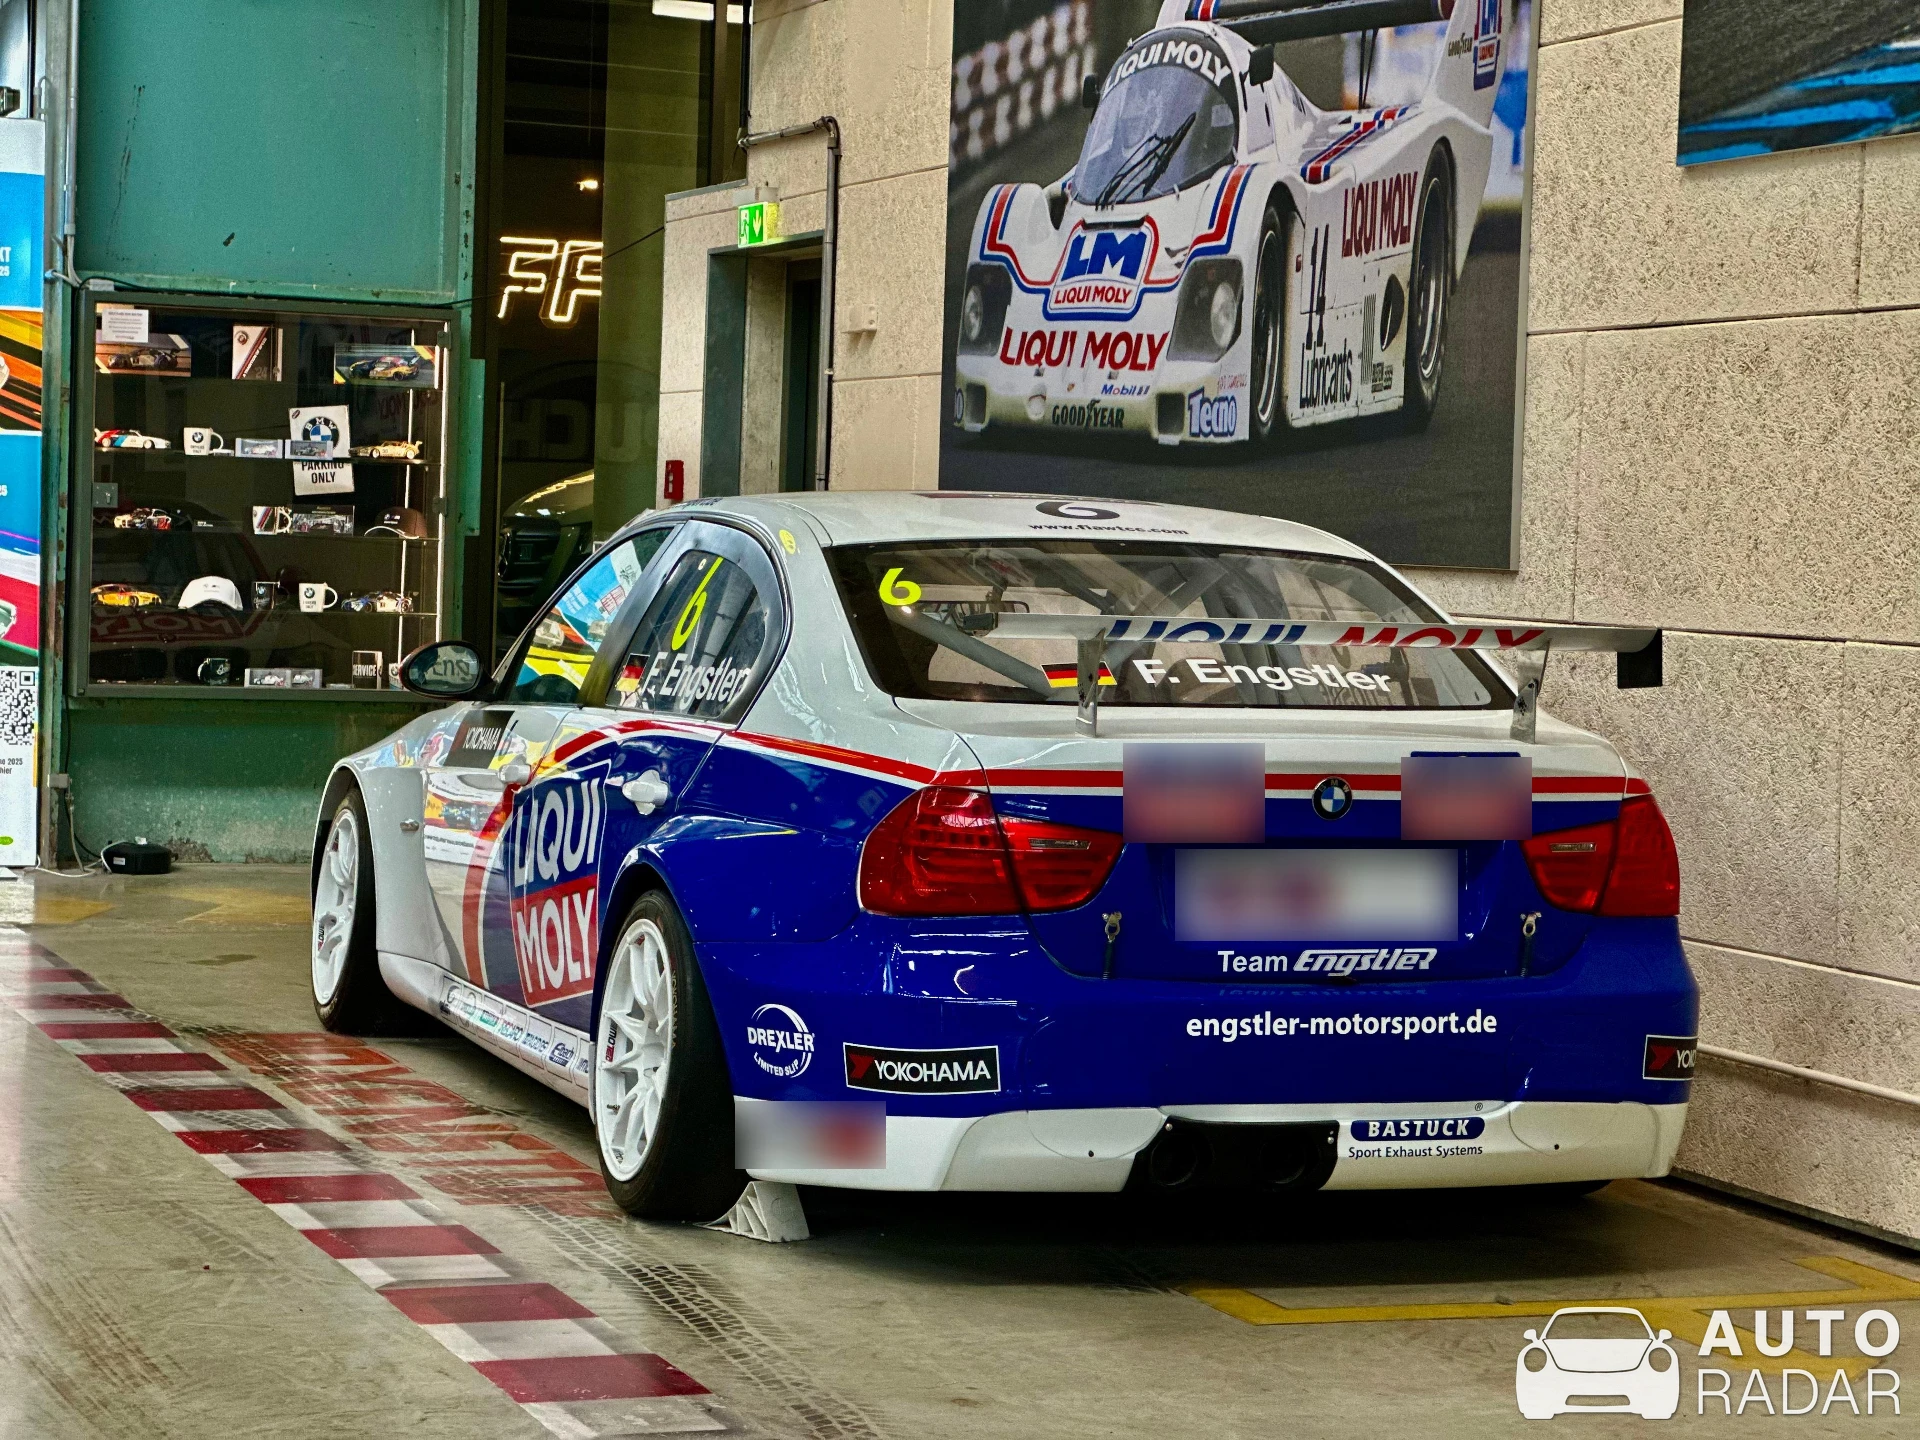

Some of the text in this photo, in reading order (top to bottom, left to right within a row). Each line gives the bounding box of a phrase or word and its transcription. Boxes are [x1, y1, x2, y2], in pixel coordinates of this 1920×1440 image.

[1101, 40, 1232, 100] LIQUI MOLY
[1341, 171, 1418, 259] LIQUI MOLY
[1061, 231, 1147, 281] LM
[1054, 285, 1132, 304] LIQUI MOLY
[1305, 223, 1329, 351] 14
[1000, 326, 1170, 371] LIQUI MOLY
[1101, 383, 1137, 396] Mobil
[1300, 337, 1353, 410] Lubricants
[305, 417, 338, 431] BMW
[1052, 398, 1125, 428] GOODYEAR
[1188, 385, 1238, 438] Tecno
[311, 471, 336, 484] ONLY
[671, 556, 724, 651] 6
[878, 567, 922, 606] 6
[659, 652, 751, 711] Engstler
[1132, 658, 1391, 692] F. Engstler
[462, 726, 502, 751] YOKOHAMA
[514, 777, 601, 888] LIQUI
[516, 888, 595, 994] MOLY
[1218, 948, 1438, 977] Team Engstler
[747, 1027, 815, 1053] DREXLER
[1186, 1009, 1497, 1043] engstler-motorsport.de
[753, 1052, 799, 1077] LIMITED SLIP
[874, 1059, 992, 1083] YOKOHAMA
[1368, 1119, 1470, 1138] BASTUCK
[1349, 1145, 1483, 1160] Sport Exhaust Systems
